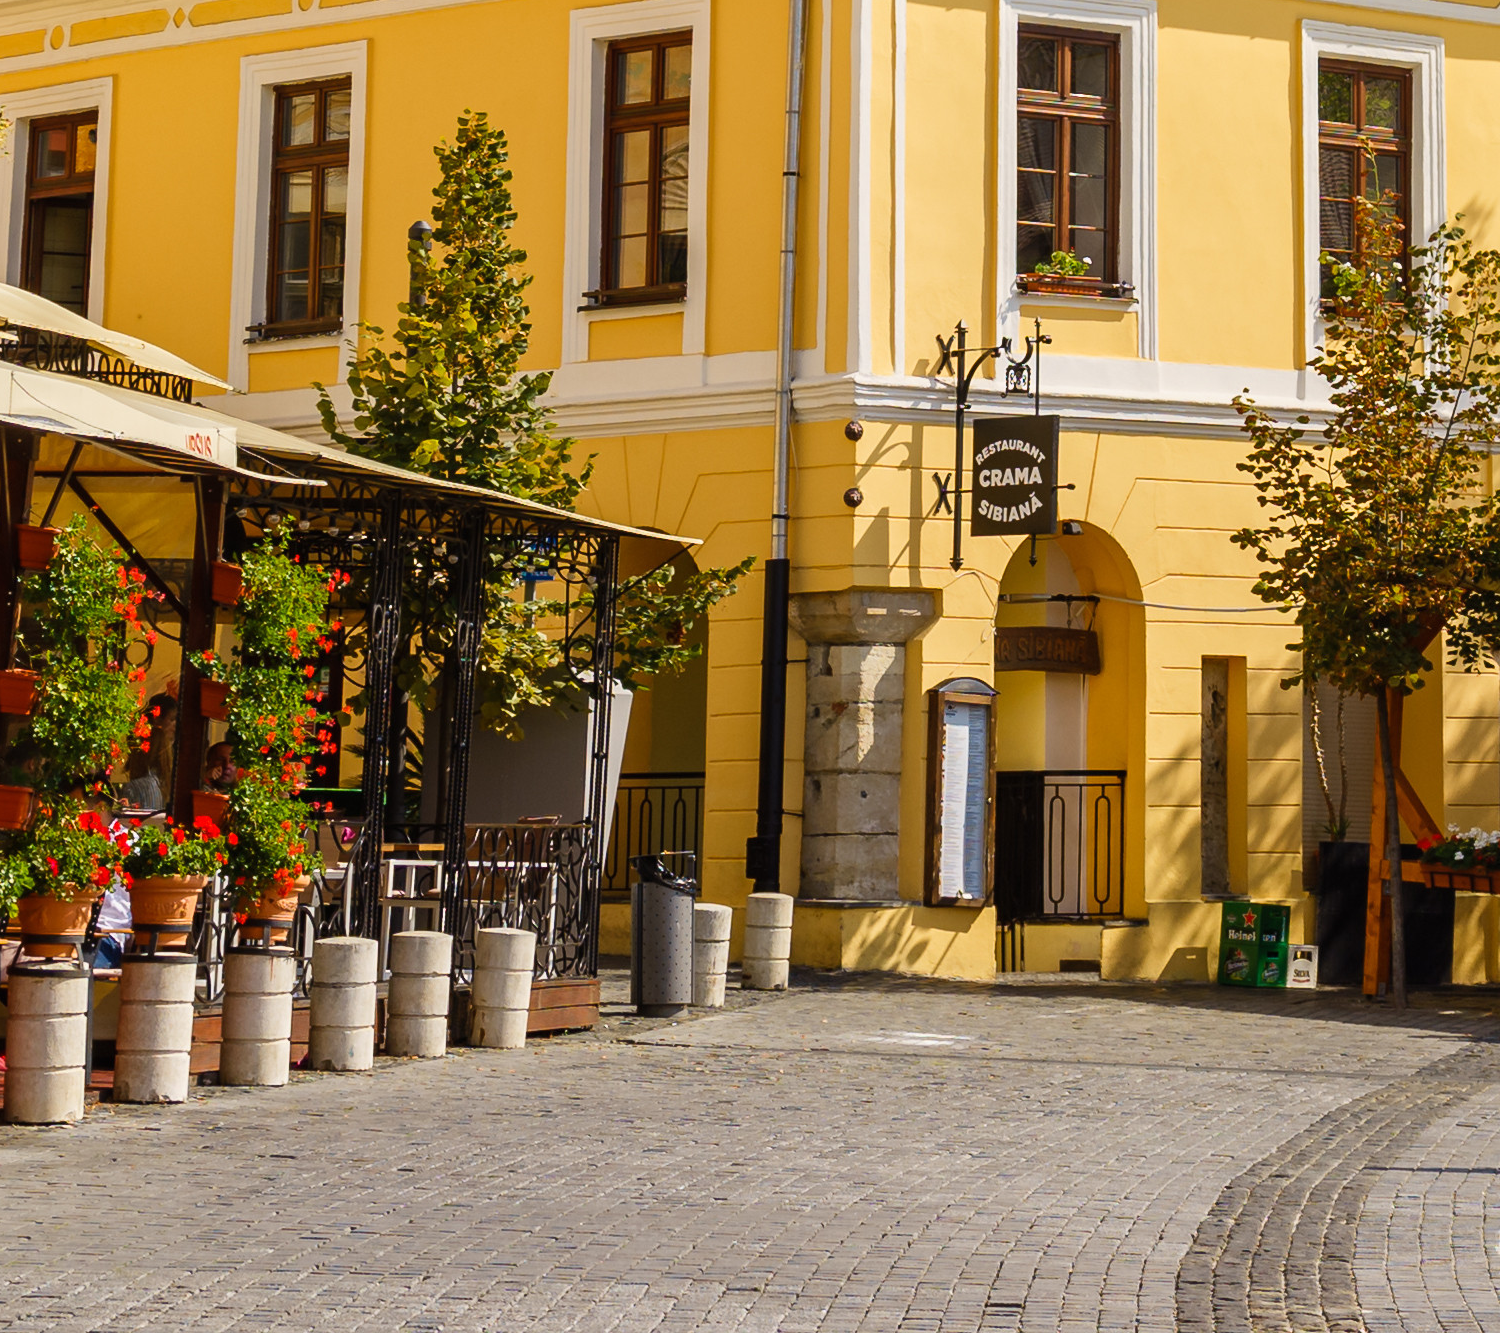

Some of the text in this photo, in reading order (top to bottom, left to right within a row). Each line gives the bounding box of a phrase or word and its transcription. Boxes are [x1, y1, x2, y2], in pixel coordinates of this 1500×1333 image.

[975, 439, 1046, 465] RESTAURANT
[979, 466, 1043, 488] CRAMA
[978, 491, 1043, 523] SIBIANĂ
